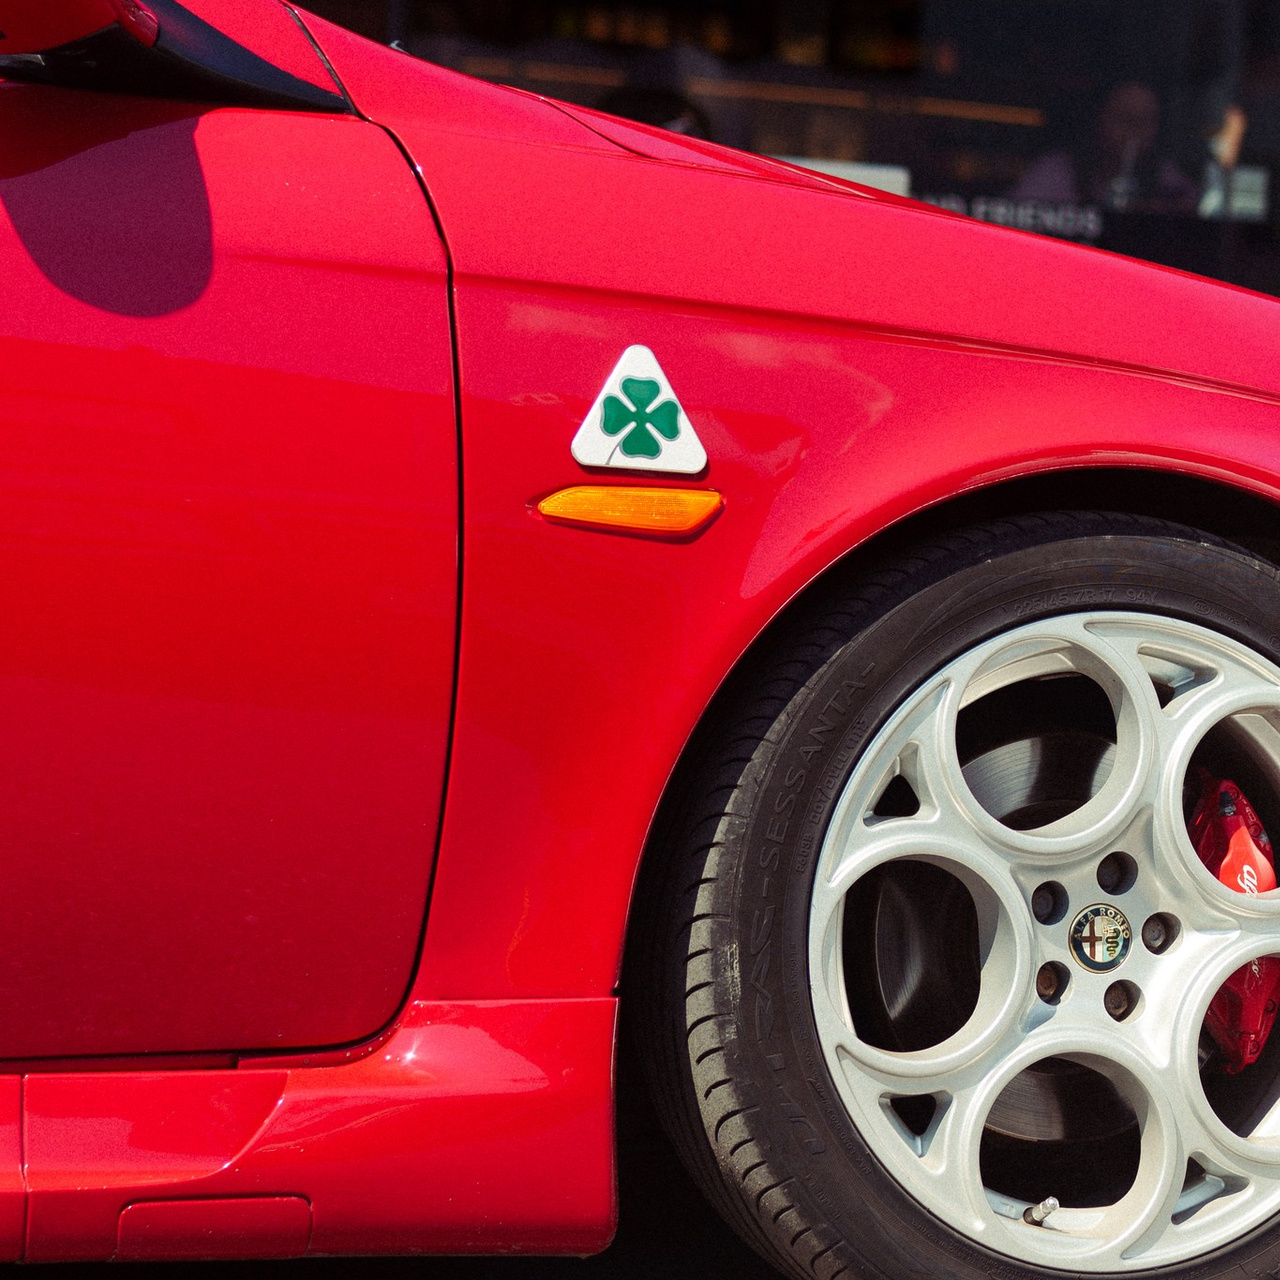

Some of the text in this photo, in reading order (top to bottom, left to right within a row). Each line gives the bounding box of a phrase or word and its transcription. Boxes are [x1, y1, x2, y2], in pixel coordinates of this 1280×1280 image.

[1013, 591, 1070, 617] 225/45
[1073, 907, 1131, 941] ALFA ROMEO
